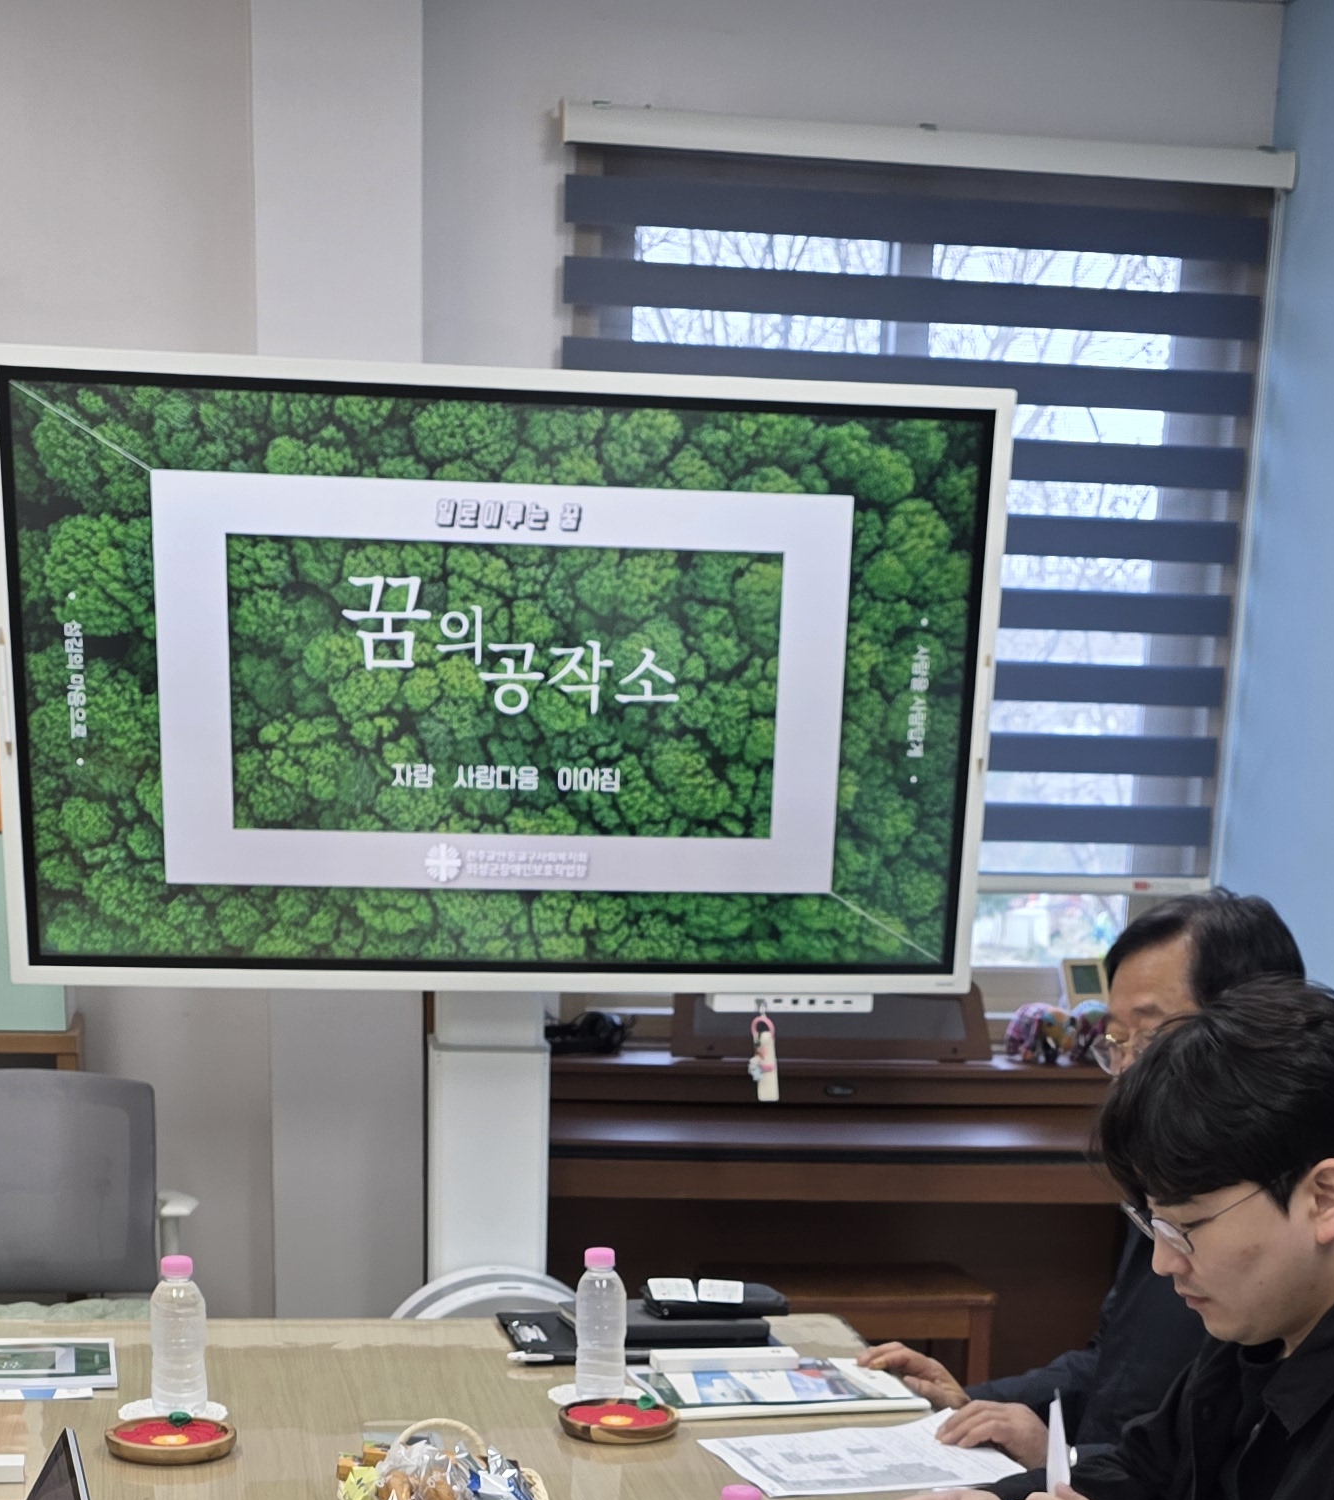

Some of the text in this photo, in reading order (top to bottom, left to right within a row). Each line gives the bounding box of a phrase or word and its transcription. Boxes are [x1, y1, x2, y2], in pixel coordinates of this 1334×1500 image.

[341, 575, 483, 670] 꿈의
[64, 619, 87, 739] 섬김의 마음으로
[479, 640, 680, 715] 공작소
[391, 763, 621, 793] 자람 사람다움 이어짐
